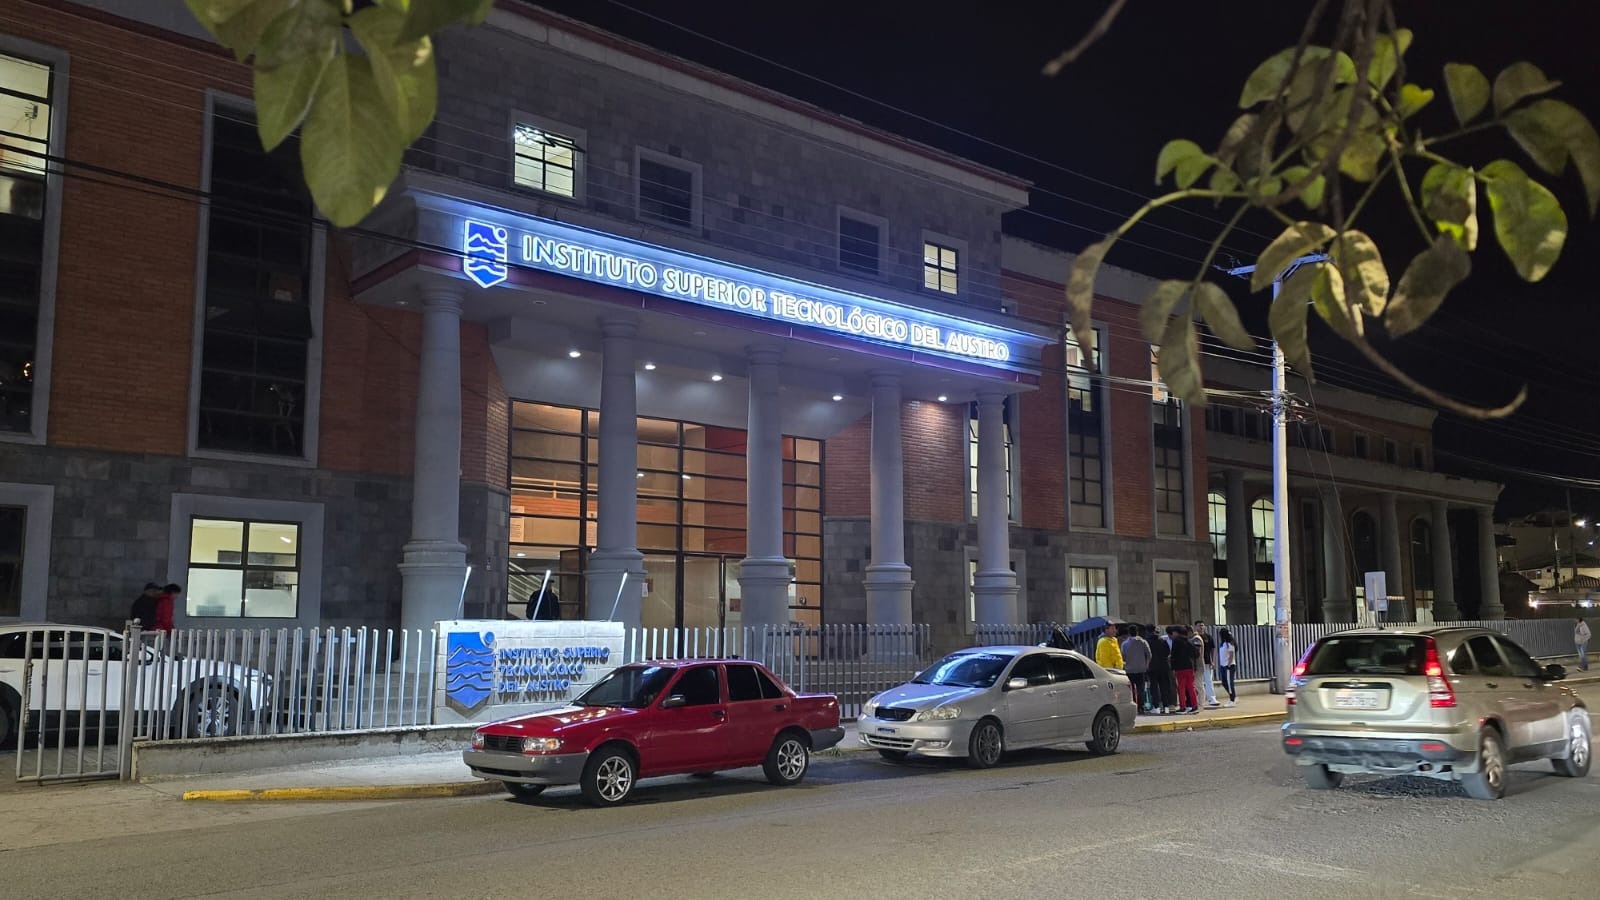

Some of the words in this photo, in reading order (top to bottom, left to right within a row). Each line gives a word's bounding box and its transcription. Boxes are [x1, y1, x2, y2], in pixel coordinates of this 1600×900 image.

[522, 235, 657, 287] INSTITUTO
[661, 266, 767, 312] SUPERIOR
[770, 292, 907, 341] TECNOLÓGICO
[912, 322, 944, 348] DEL
[945, 333, 1010, 361] AUSTRO
[499, 647, 560, 660] INSTITUTO
[498, 680, 521, 693] DEL
[526, 678, 570, 692] AUSTRO
